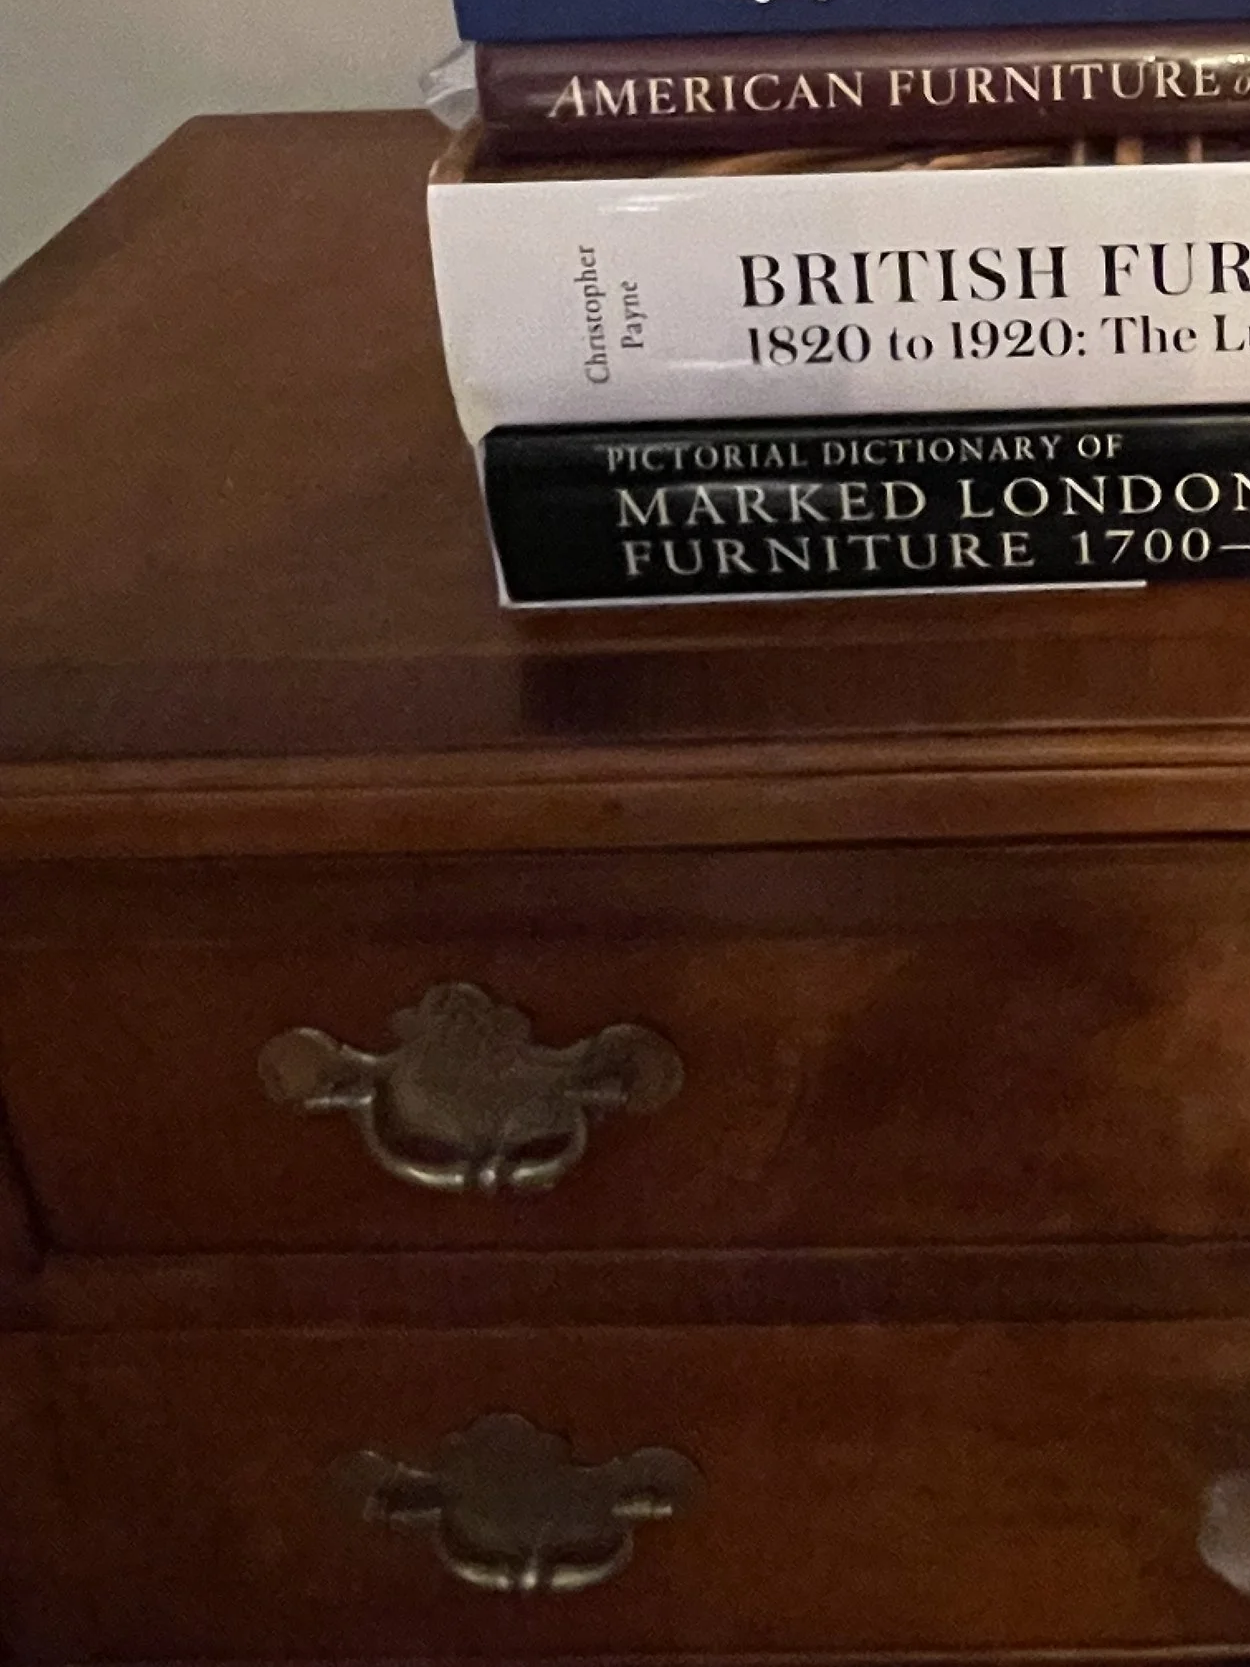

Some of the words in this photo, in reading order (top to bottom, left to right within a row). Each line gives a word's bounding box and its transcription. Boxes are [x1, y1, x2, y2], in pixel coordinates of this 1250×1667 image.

[546, 71, 865, 120] AMERICAN
[888, 61, 1223, 110] FURNITURE
[739, 245, 1068, 309] BRITISH
[583, 244, 611, 385] Christopher
[620, 279, 647, 350] Payne
[747, 324, 871, 367] 1820
[890, 329, 934, 361] to
[951, 319, 1087, 360] 1920:
[1101, 314, 1198, 355] The
[606, 443, 807, 476] PICTORIAL
[823, 435, 1058, 469] DICTIONARY
[1077, 433, 1124, 460] OF
[615, 482, 928, 529] MARKED
[624, 534, 1037, 578] FURNITURE
